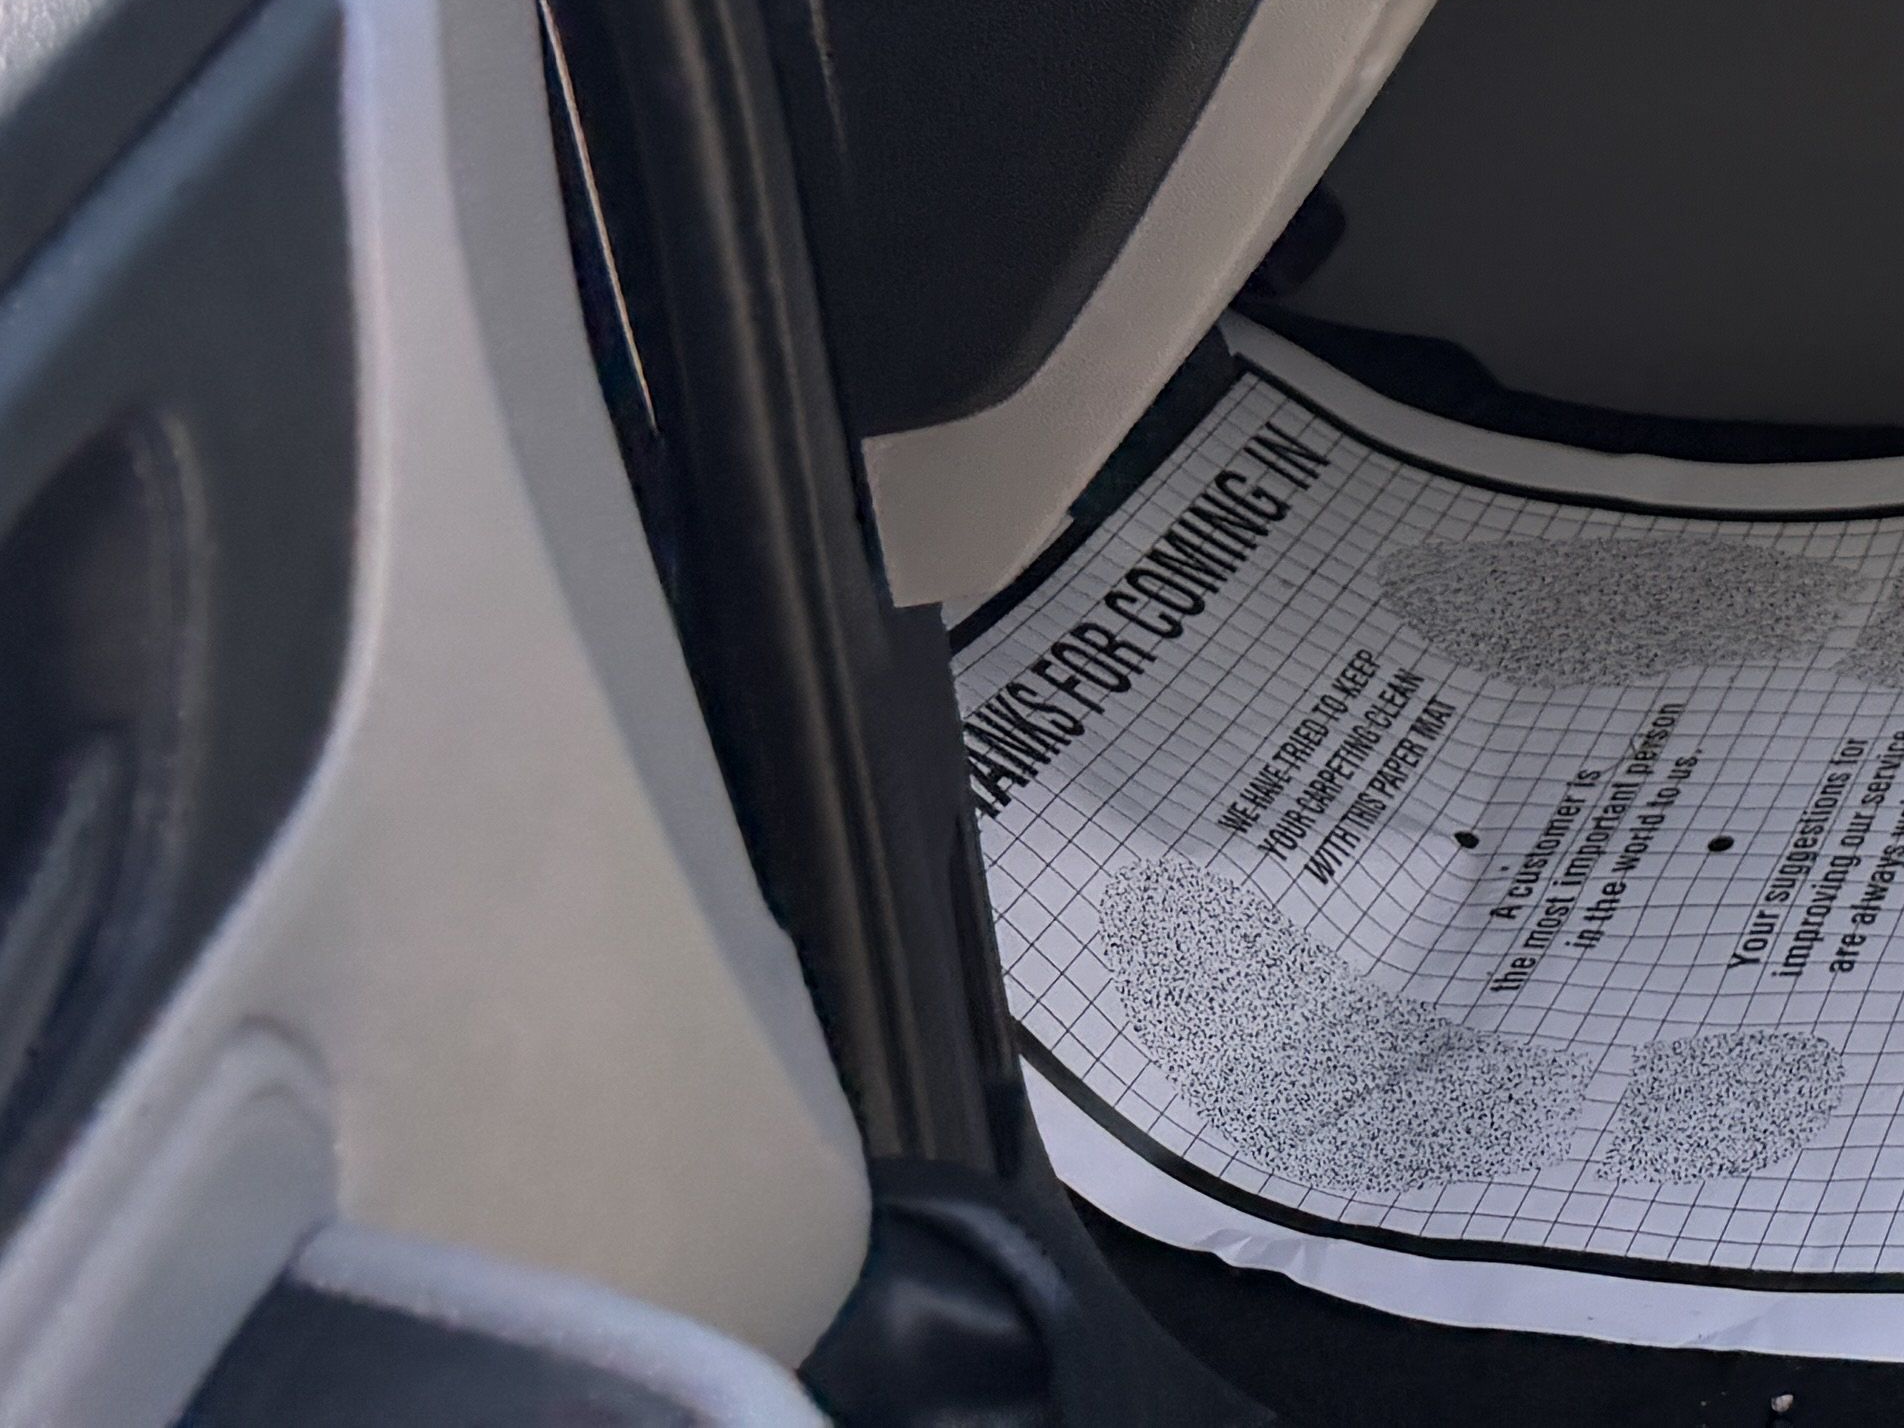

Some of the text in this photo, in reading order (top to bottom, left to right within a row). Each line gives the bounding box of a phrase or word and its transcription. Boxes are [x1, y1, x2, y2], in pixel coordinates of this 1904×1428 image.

[964, 421, 1331, 820] ANKS FOR COMING IN
[1218, 648, 1380, 834] WE HAVE TRIED TO KEEP
[1258, 668, 1425, 861] YOUR CARPETING CLEAN
[1304, 697, 1456, 886] WITH THIS PAPER MAT
[1490, 769, 1601, 919] A customer is
[1490, 702, 1687, 993] the most important person
[1565, 749, 1703, 949] in the world to us.
[1727, 738, 1869, 969] Your suggestions for
[1772, 854, 1862, 977] improving
[1840, 812, 1877, 848] our
[1829, 934, 1867, 974] are
